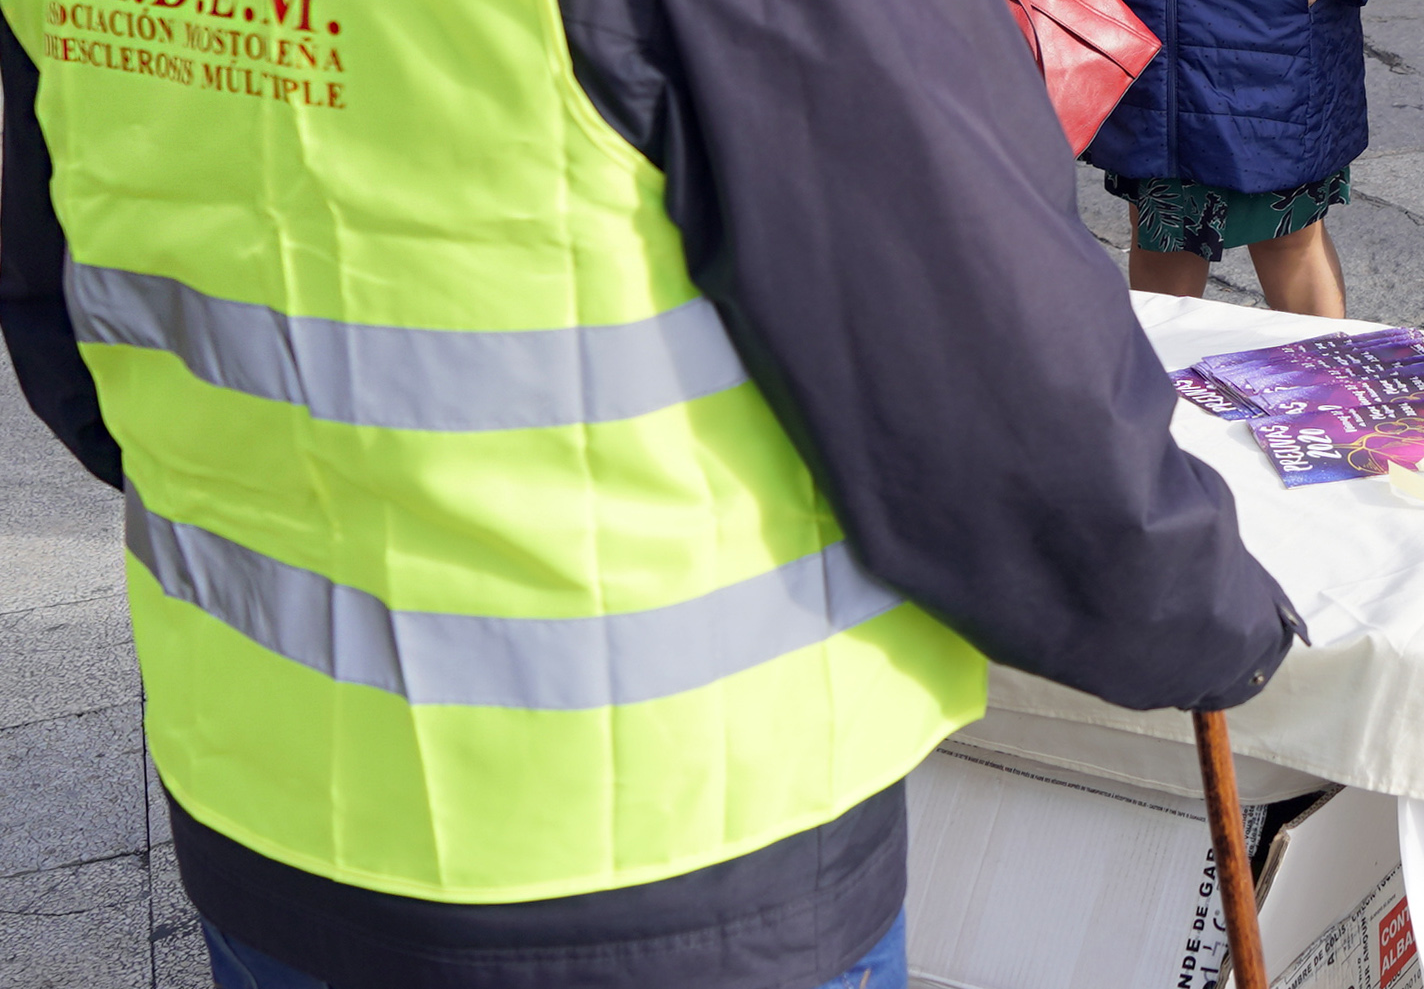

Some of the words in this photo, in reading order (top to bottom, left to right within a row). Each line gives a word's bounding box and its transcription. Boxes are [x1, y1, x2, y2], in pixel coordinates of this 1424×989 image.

[1260, 424, 1313, 473] PREUVAS
[1296, 428, 1342, 459] 2020
[1177, 938, 1202, 989] NDE
[1192, 904, 1209, 931] DE
[1381, 930, 1415, 976] ALBA
